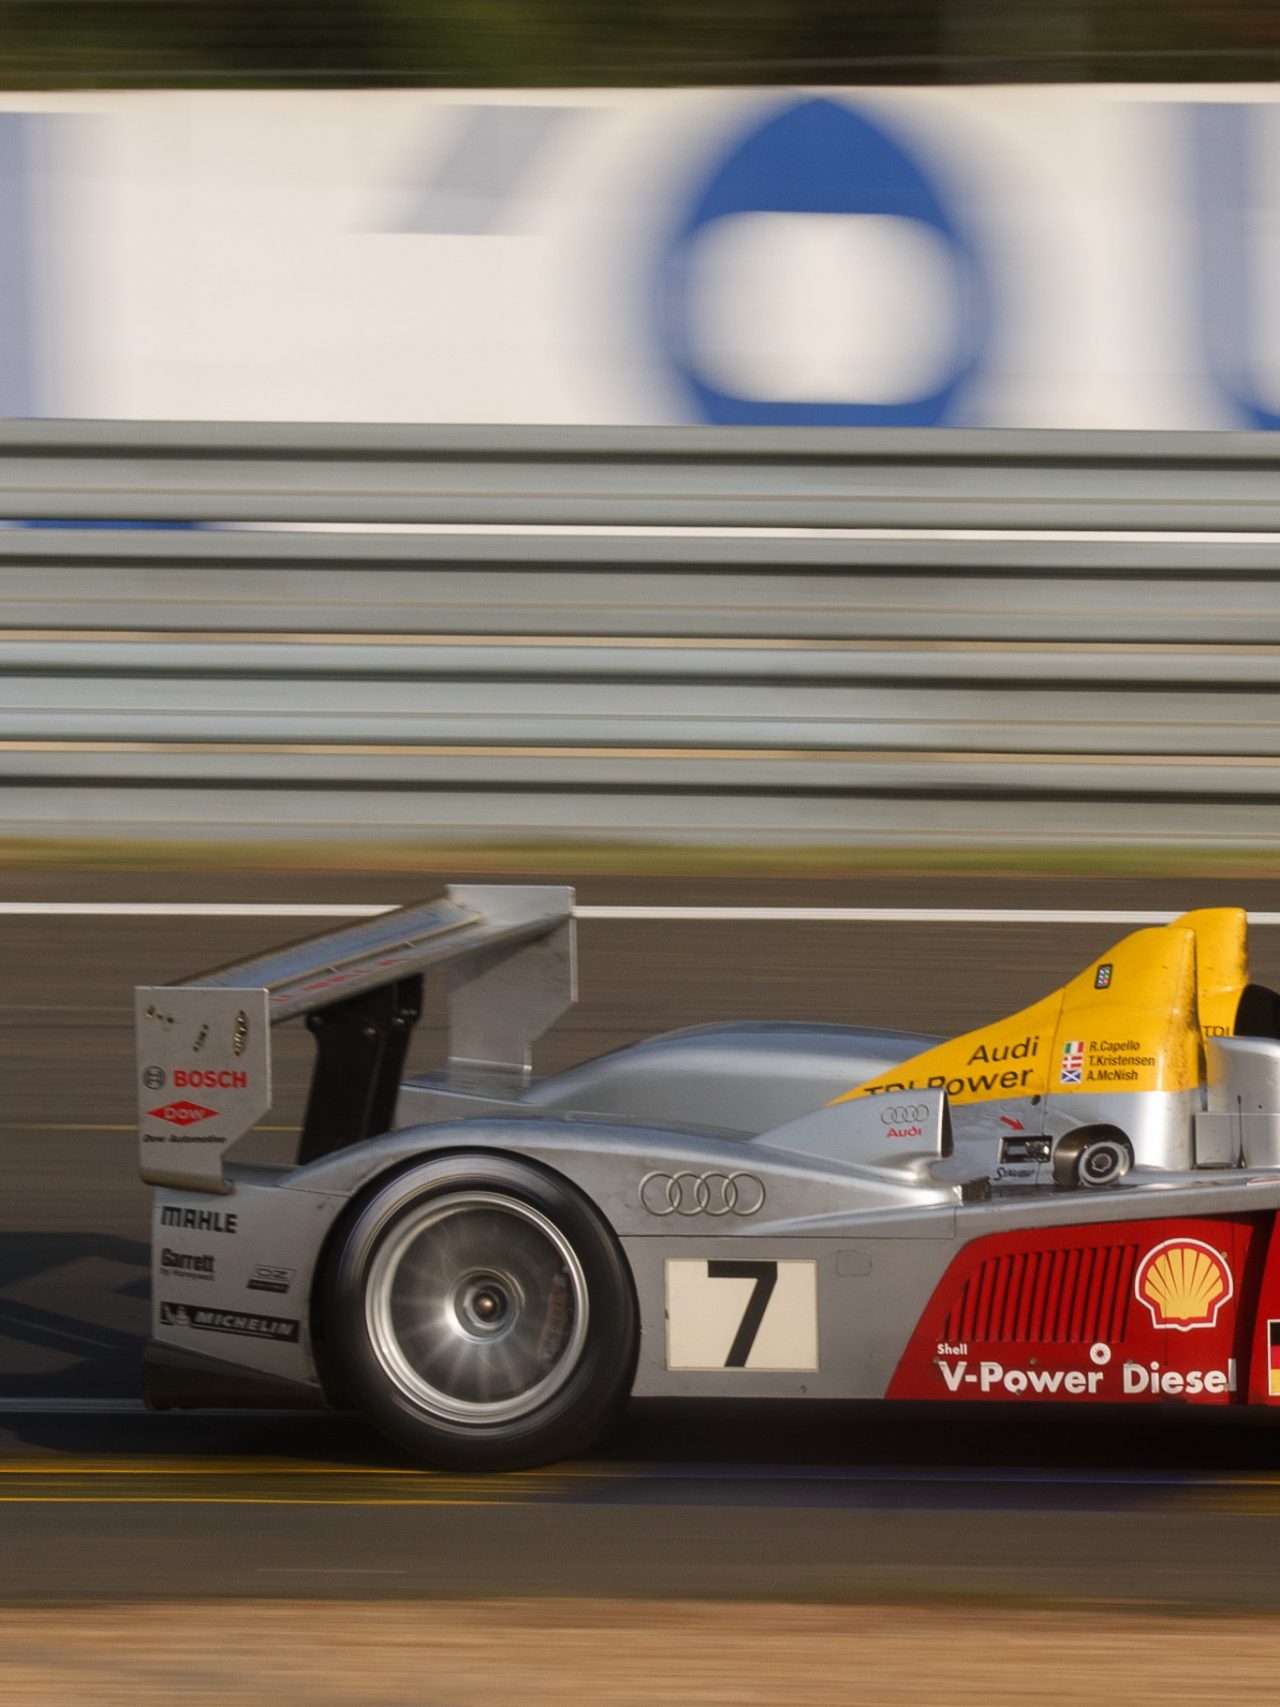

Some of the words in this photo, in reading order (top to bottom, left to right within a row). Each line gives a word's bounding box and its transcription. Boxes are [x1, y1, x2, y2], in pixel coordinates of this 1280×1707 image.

[967, 1035, 1039, 1066] Audi
[173, 1070, 247, 1088] BOSCH
[927, 1069, 1033, 1096] Power
[1087, 1069, 1138, 1081] A.McNish
[886, 1126, 921, 1138] Audi
[161, 1206, 238, 1234] MAHLE
[195, 1311, 294, 1336] MICHELIN
[708, 1260, 778, 1367] 7
[937, 1343, 968, 1355] Shell
[939, 1361, 1104, 1393] V-Power
[1123, 1358, 1237, 1394] Diesel
